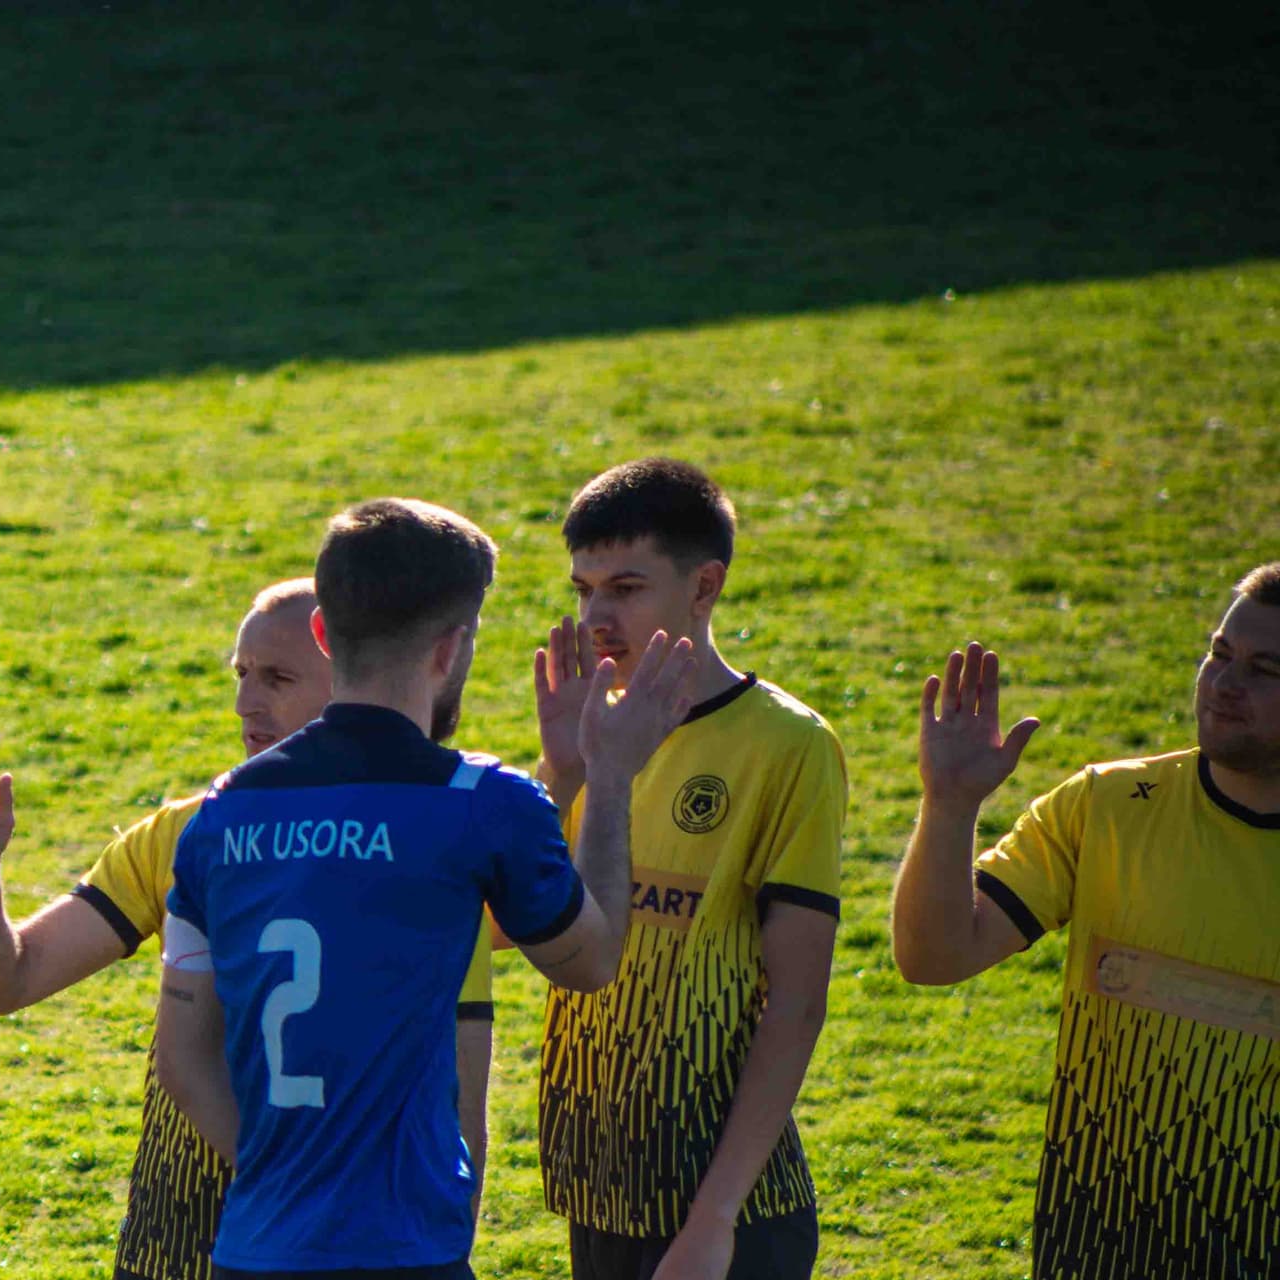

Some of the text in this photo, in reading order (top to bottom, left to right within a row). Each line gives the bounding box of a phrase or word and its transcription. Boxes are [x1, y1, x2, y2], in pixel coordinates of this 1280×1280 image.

[223, 819, 394, 865] NK USORA
[257, 918, 326, 1109] 2
